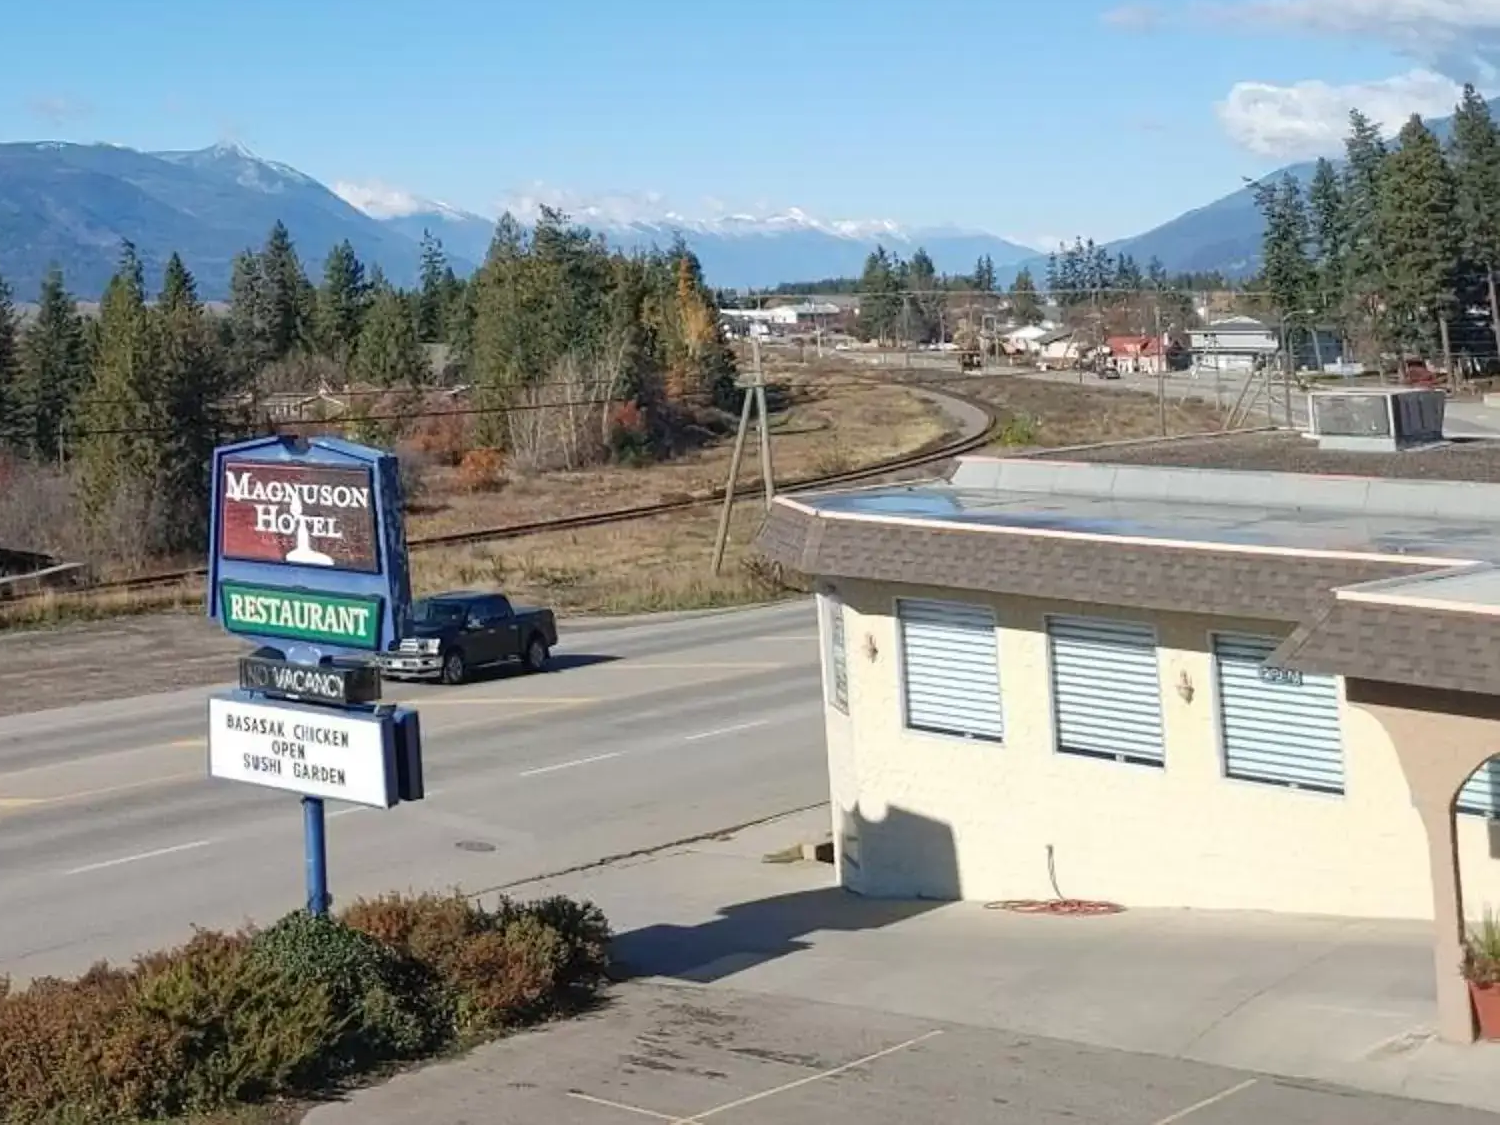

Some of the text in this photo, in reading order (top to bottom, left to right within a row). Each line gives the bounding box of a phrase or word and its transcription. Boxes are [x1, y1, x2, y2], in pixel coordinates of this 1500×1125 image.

[225, 470, 369, 508] MAGNUSON
[255, 504, 343, 539] HOTEL
[230, 594, 369, 636] RESTAURANT
[272, 666, 344, 698] VACANCY
[226, 713, 349, 748] BASASAK CHICKEN
[271, 739, 307, 760] OPEN
[243, 753, 346, 786] SUSHI GARDEN
